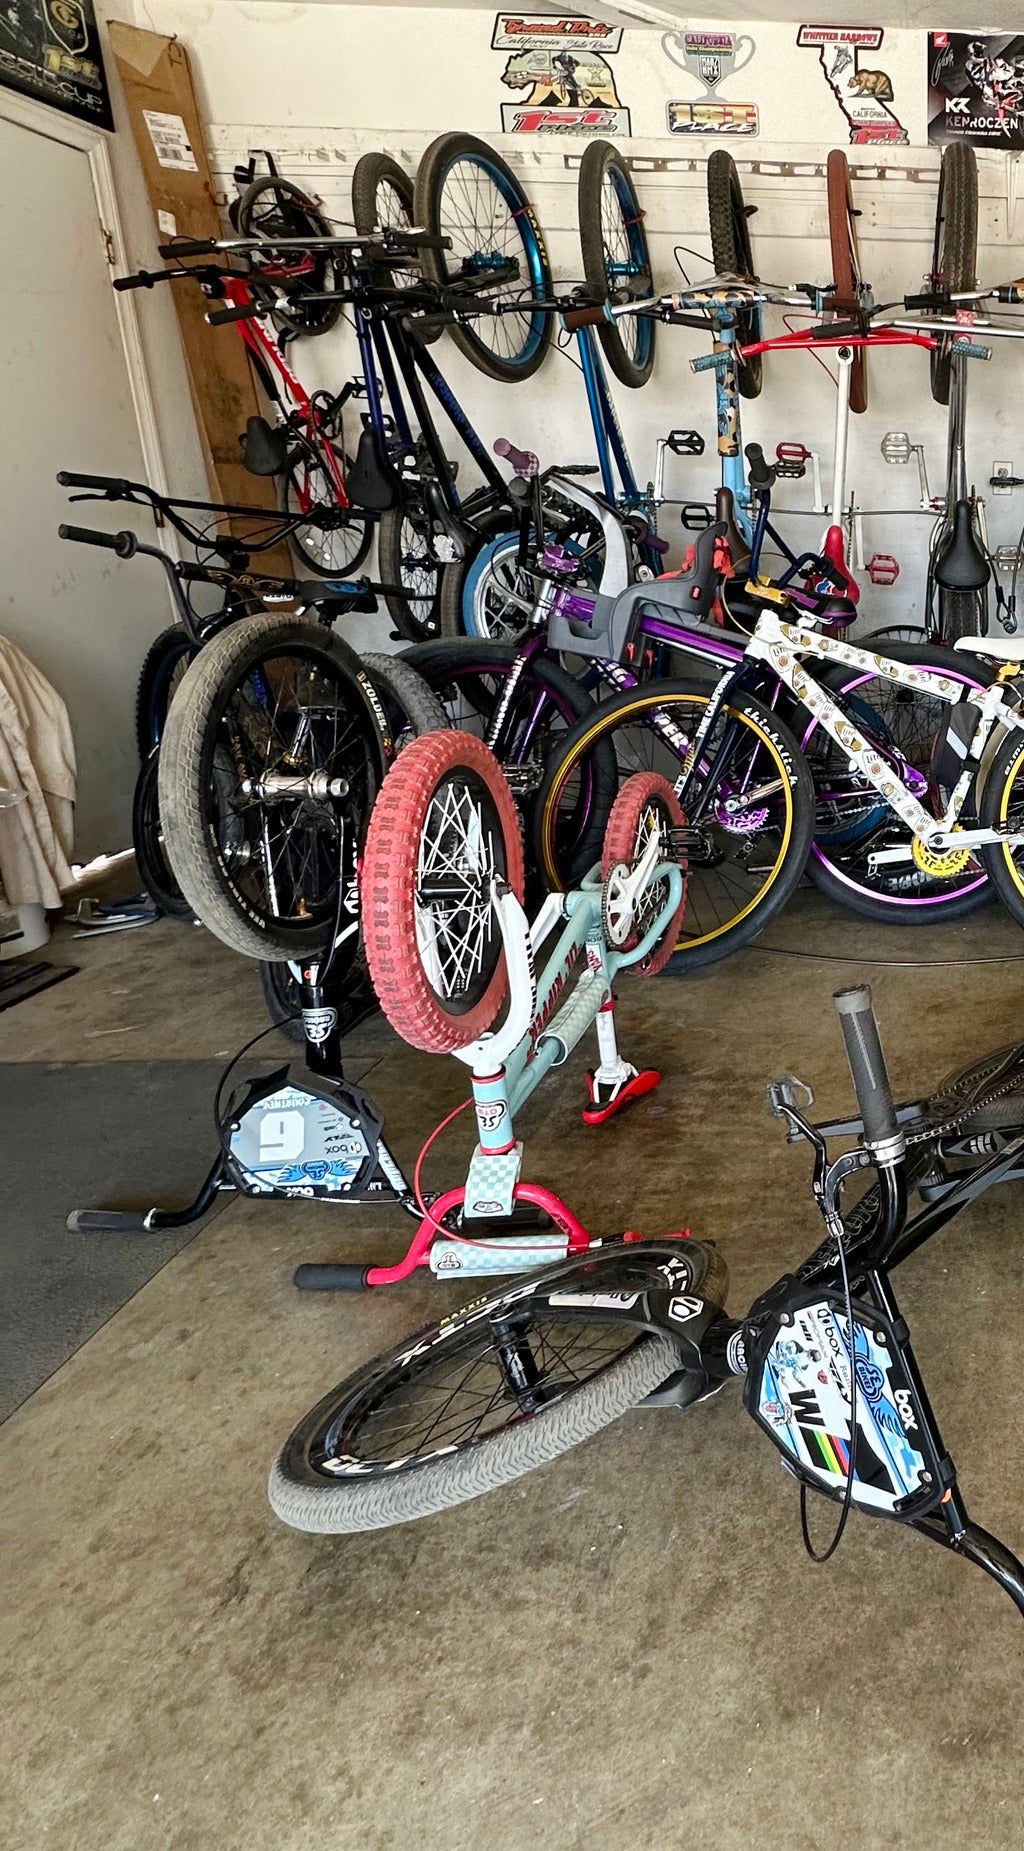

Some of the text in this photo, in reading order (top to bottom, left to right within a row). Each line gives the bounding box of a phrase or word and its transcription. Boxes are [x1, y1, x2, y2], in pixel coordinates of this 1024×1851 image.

[852, 110, 888, 118] CALIFORNIA
[672, 121, 756, 133] PLACE
[325, 1145, 349, 1155] box
[440, 1296, 488, 1326] MAXXIS
[824, 1325, 845, 1359] box
[857, 1363, 872, 1391] BIKES
[865, 1366, 883, 1387] SE
[894, 1388, 919, 1432] box
